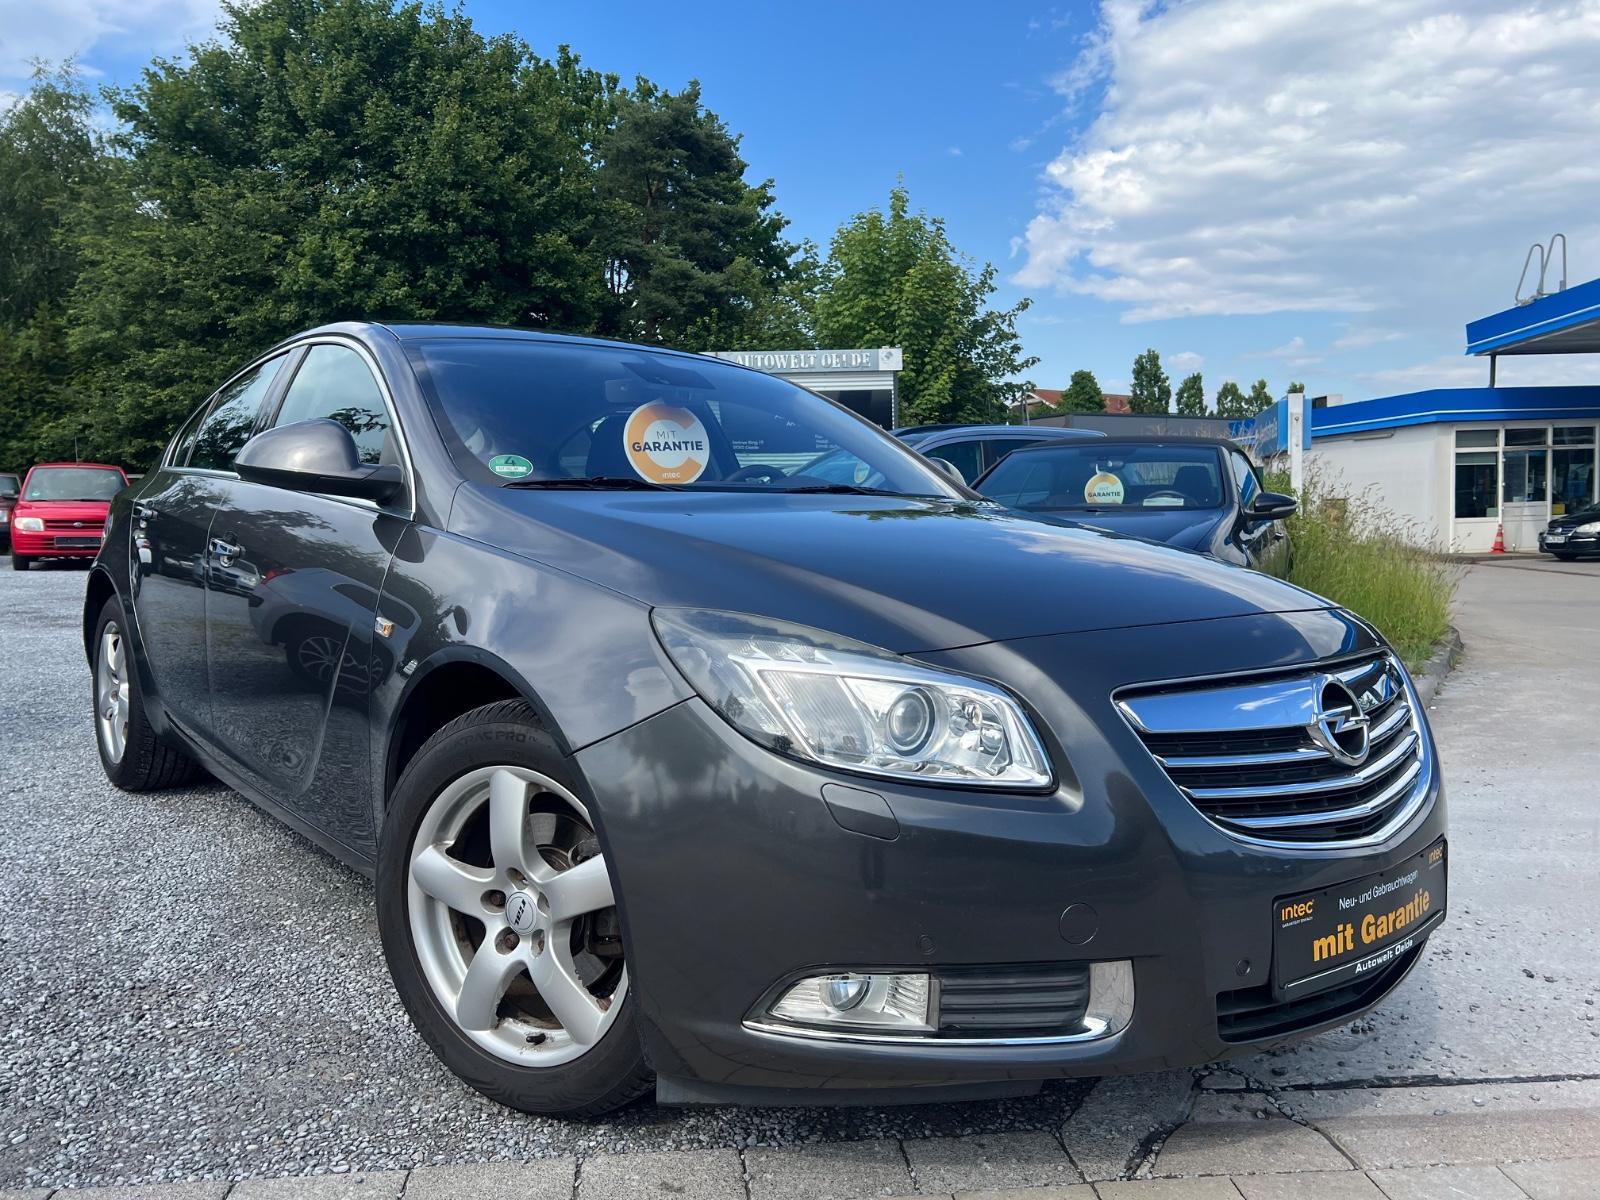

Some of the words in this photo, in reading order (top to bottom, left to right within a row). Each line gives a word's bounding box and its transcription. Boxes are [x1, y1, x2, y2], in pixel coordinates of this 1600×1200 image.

[735, 353, 817, 369] AUTOWELT
[656, 430, 676, 440] MIT
[632, 440, 703, 452] GARANTIE
[504, 456, 516, 466] 4
[1339, 897, 1357, 910] Neu-
[1359, 888, 1373, 904] und
[1372, 870, 1418, 899] Gebrauchtwagen
[1281, 901, 1314, 921] intec
[1313, 923, 1354, 961] mit
[1361, 889, 1430, 944] Garantie
[1355, 950, 1394, 974] Autowelt
